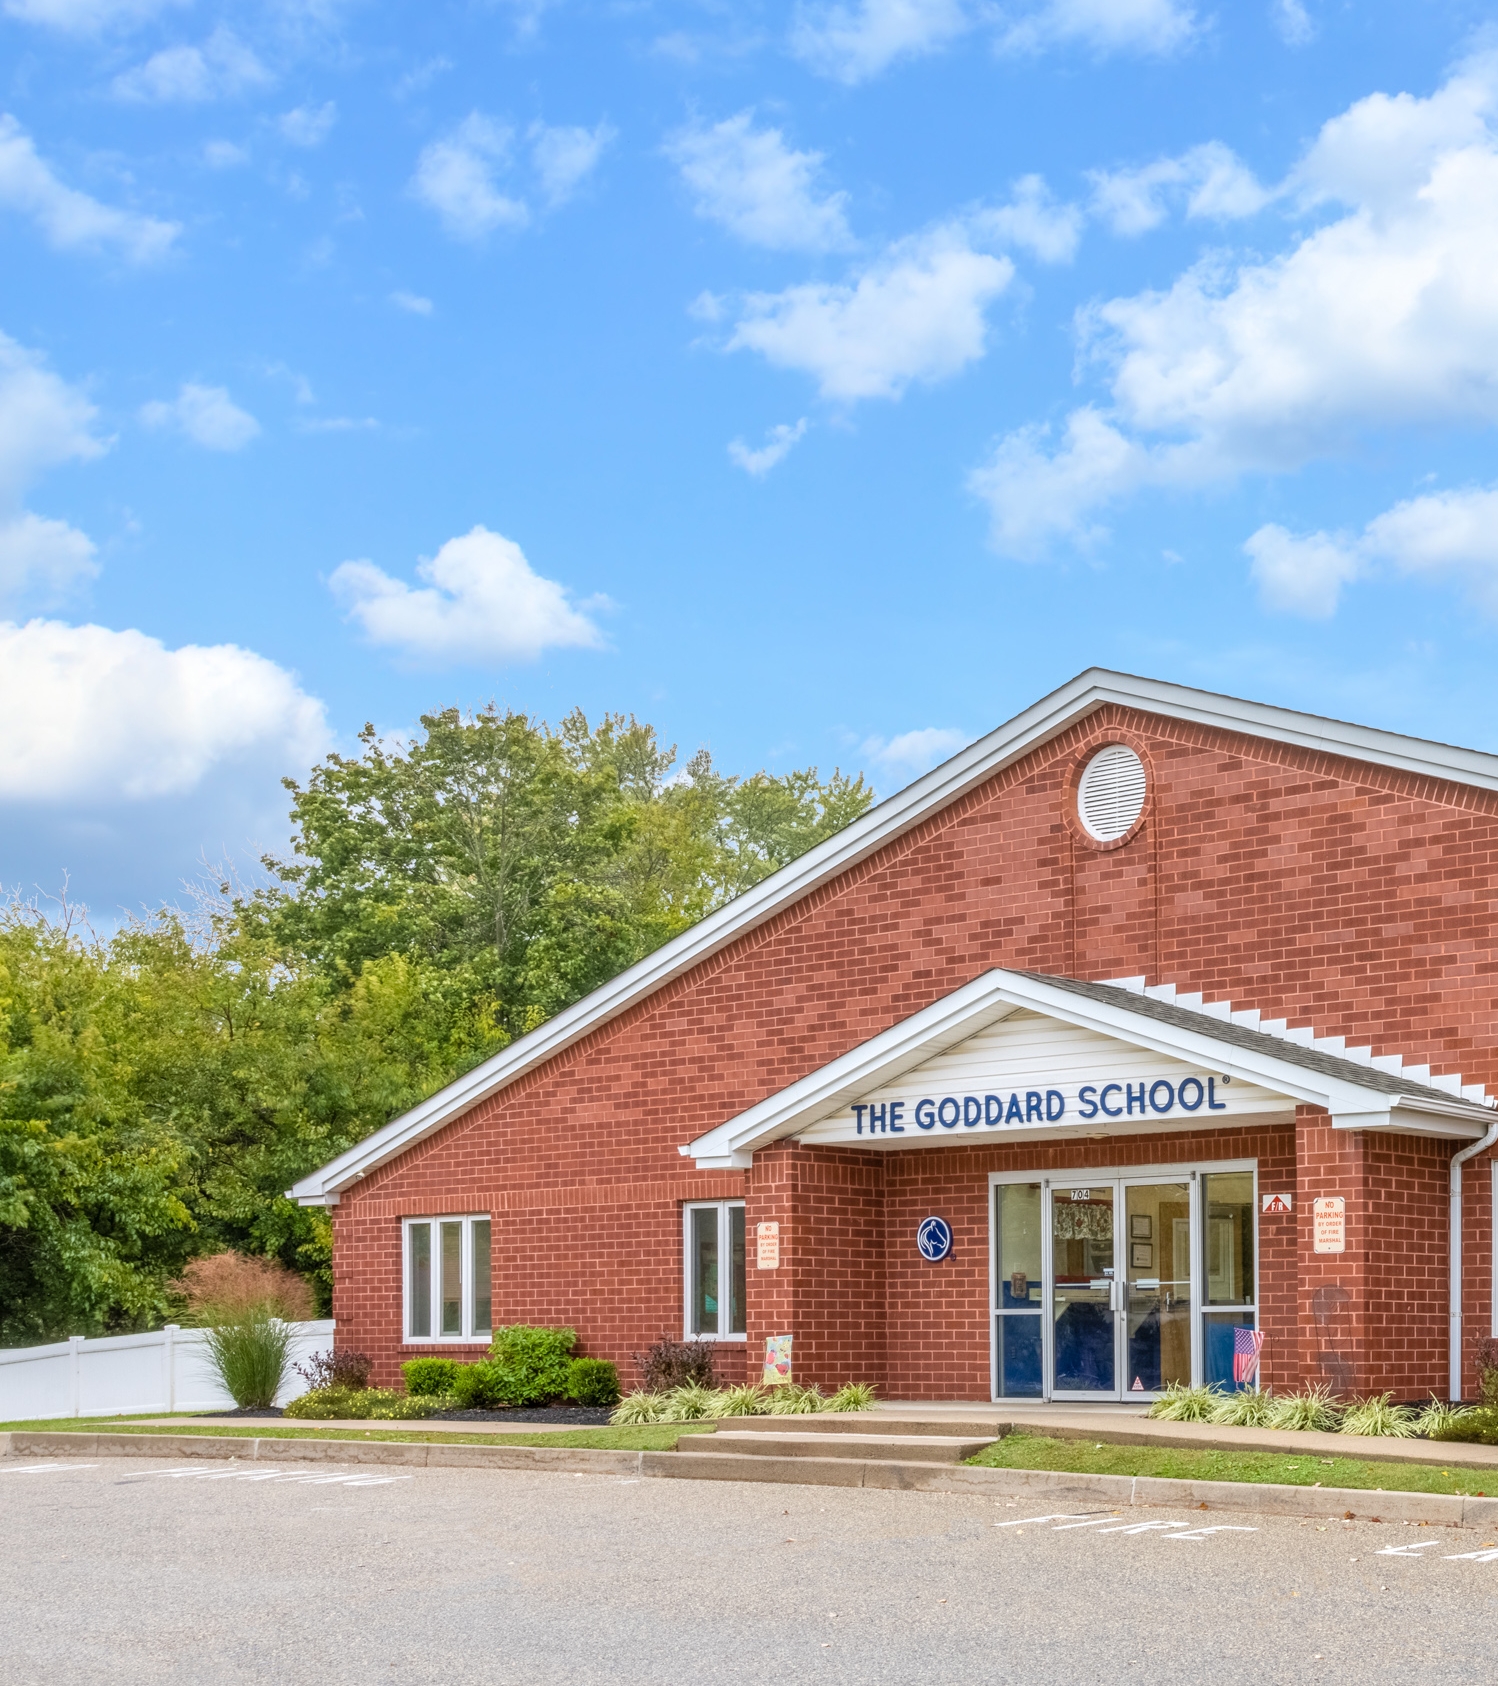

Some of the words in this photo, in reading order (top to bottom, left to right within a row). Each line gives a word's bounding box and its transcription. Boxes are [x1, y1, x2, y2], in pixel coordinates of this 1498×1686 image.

[851, 1102, 905, 1134] THE
[915, 1090, 1065, 1130] GODDARD
[1072, 1190, 1089, 1199] 704
[1271, 1202, 1283, 1211] F/R
[122, 1467, 413, 1486] PARKING
[994, 1514, 1260, 1539] FIRE
